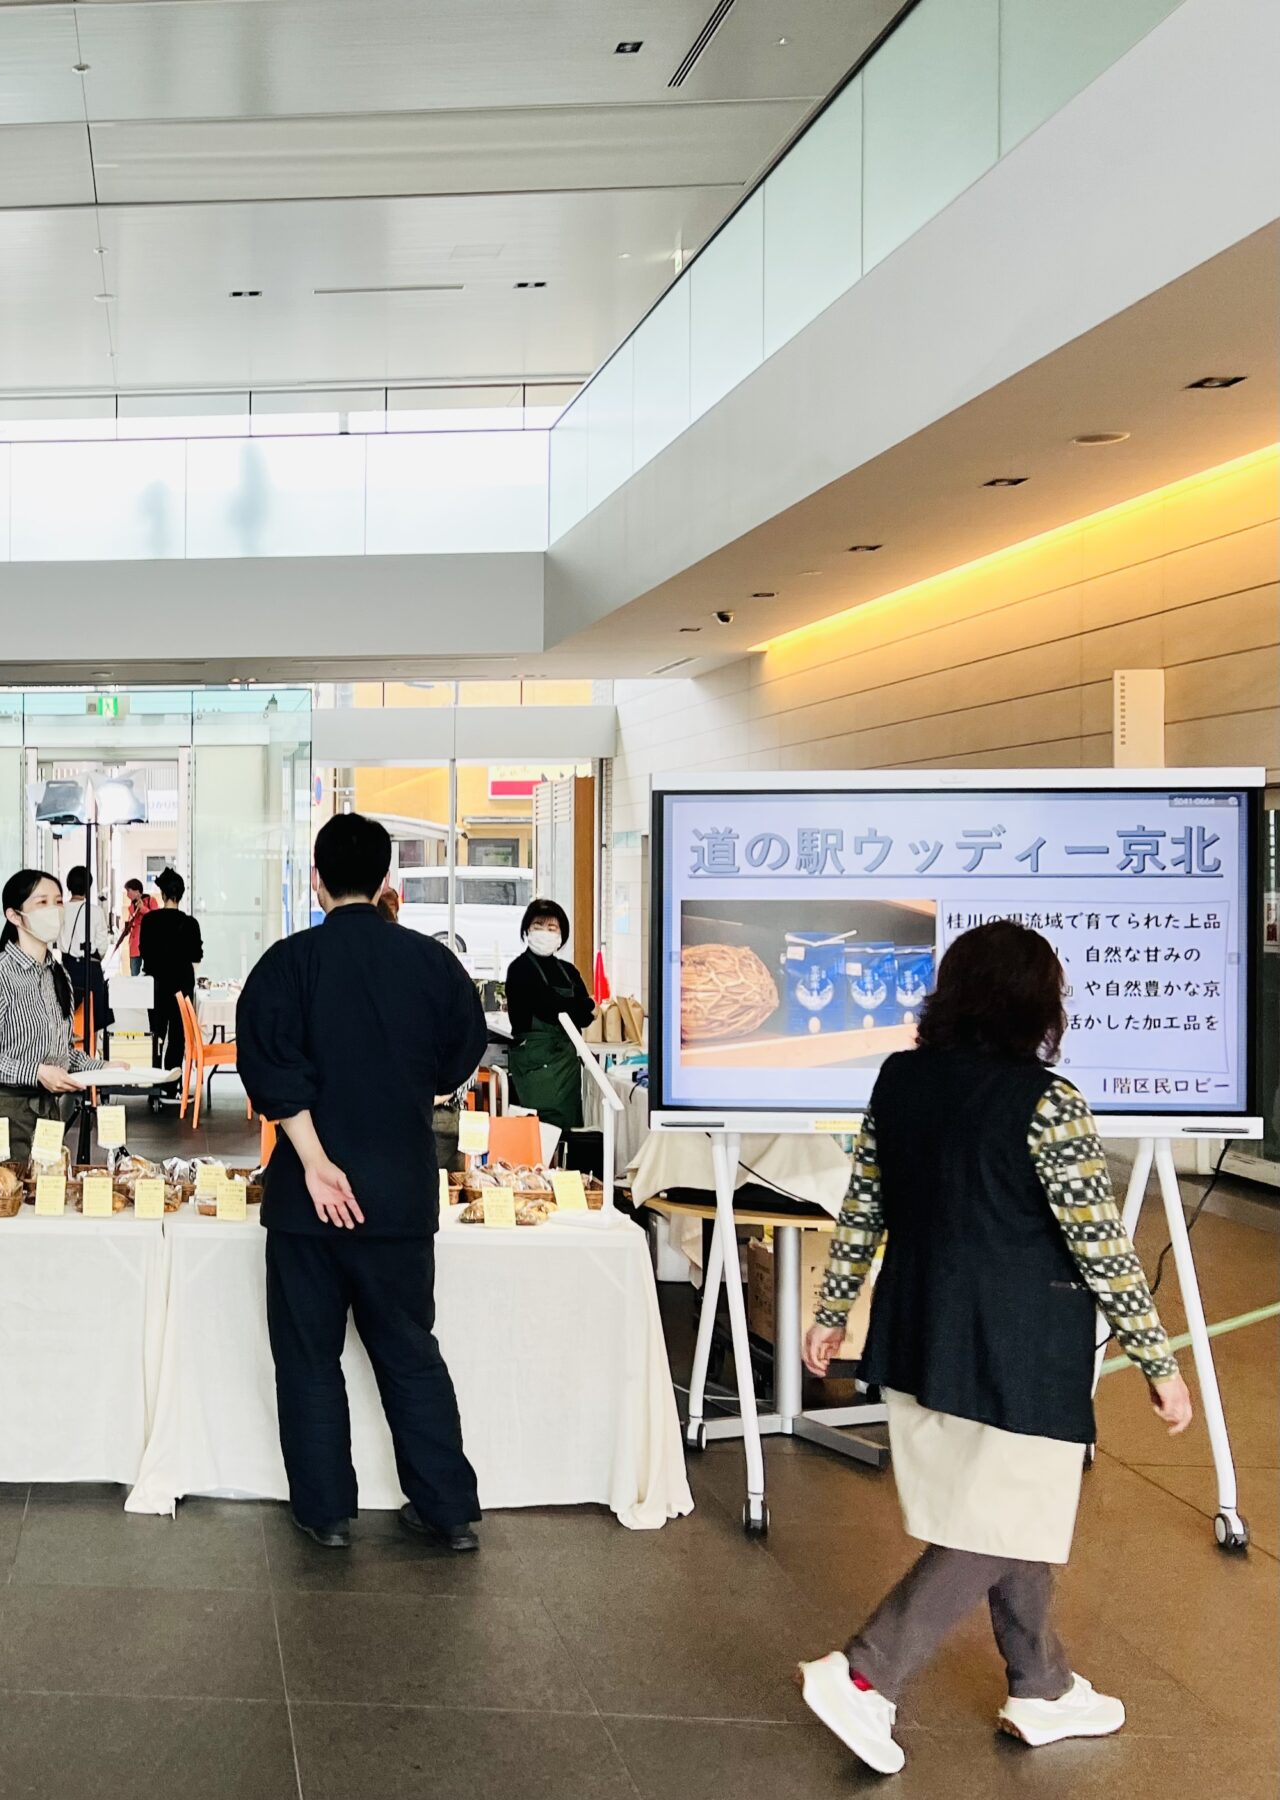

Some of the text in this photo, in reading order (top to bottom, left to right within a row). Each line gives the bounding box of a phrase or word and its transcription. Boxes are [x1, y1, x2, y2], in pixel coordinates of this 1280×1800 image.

[689, 824, 1223, 874] 道の駅ウッディー京北
